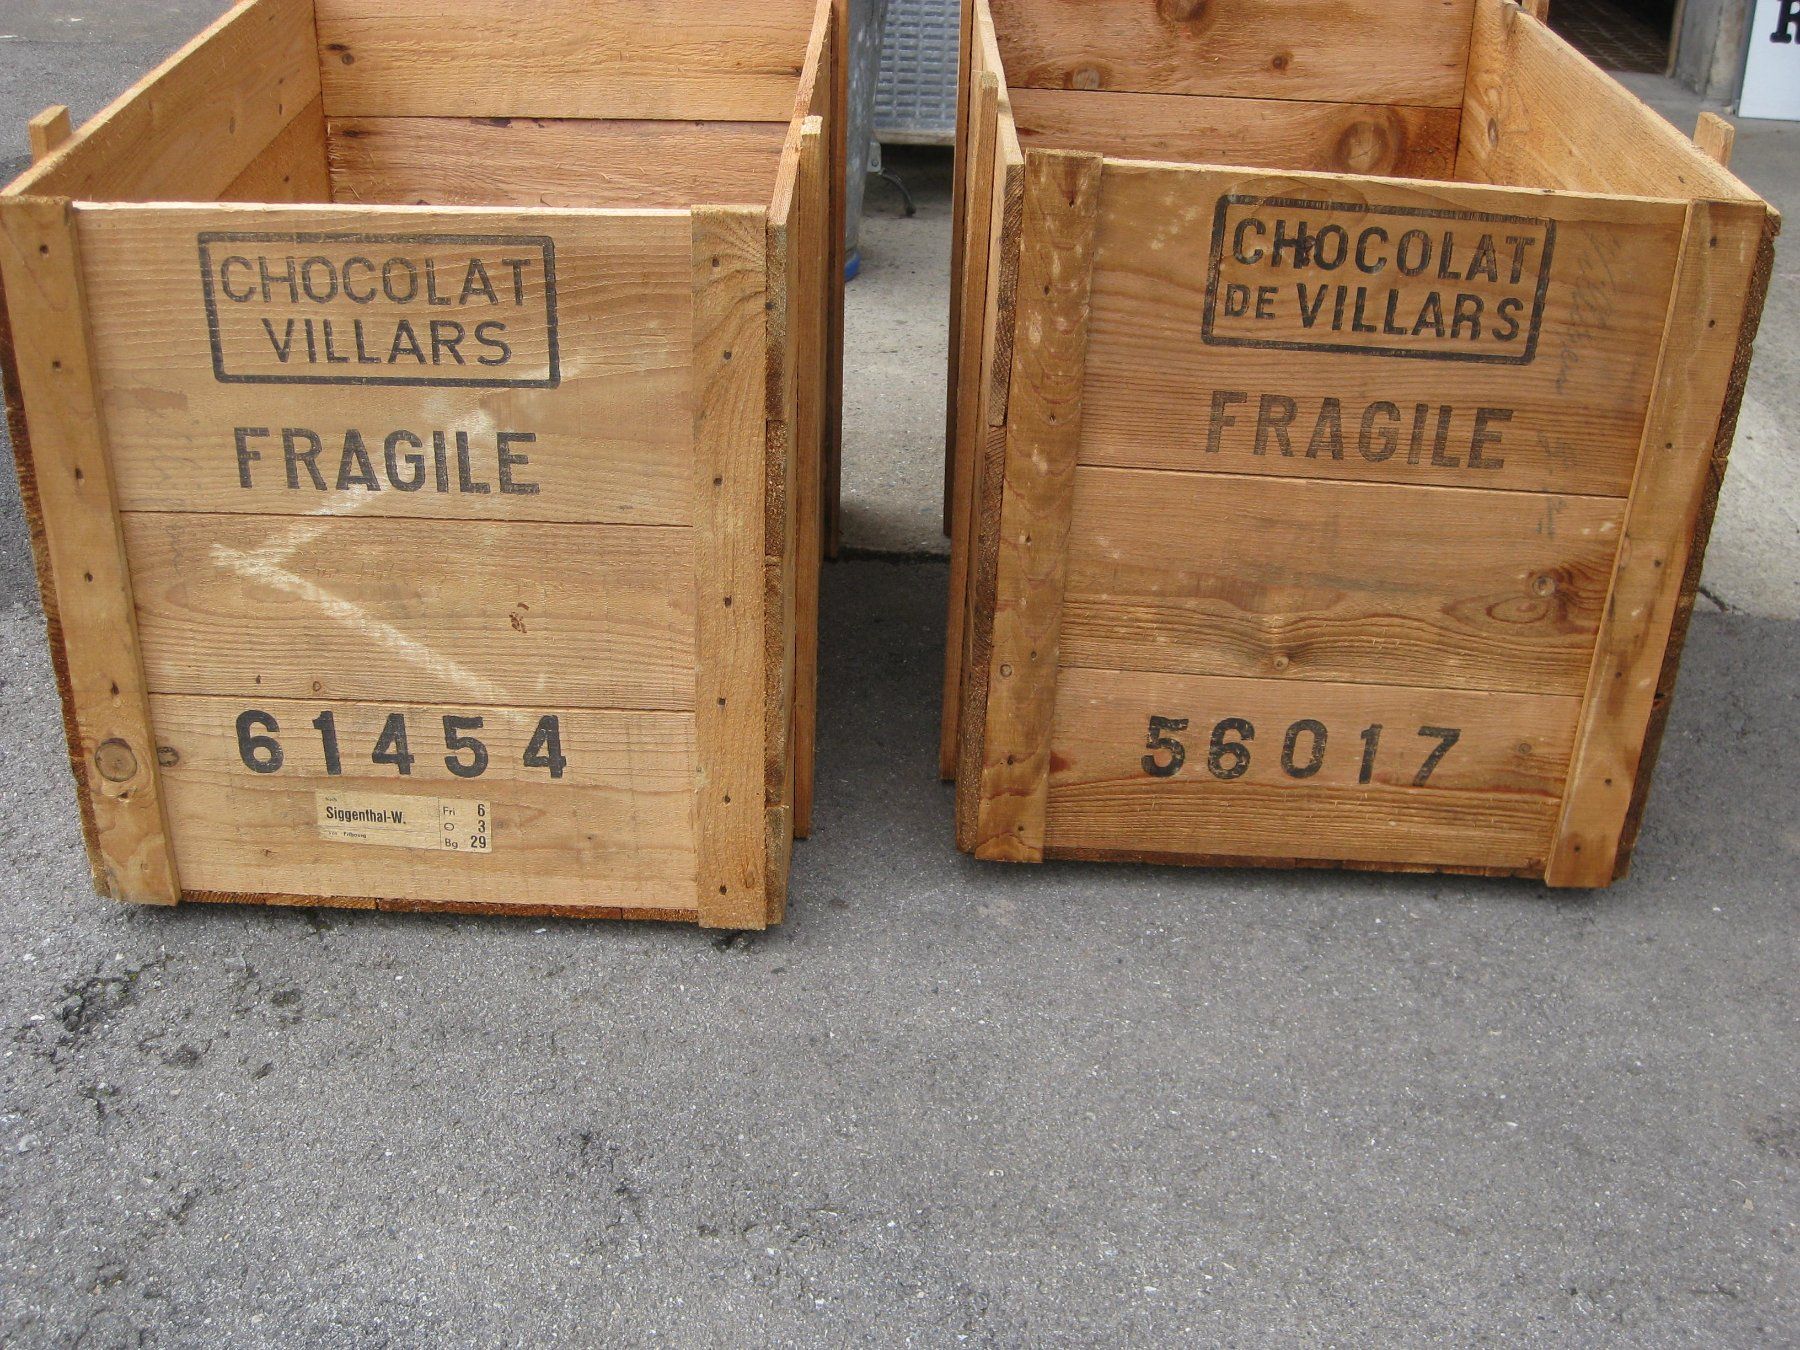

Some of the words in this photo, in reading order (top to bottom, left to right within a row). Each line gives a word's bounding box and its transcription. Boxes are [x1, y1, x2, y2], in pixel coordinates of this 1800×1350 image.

[1232, 217, 1536, 285] CHOCOLAT
[220, 255, 532, 306] CHOCOLAT
[1224, 283, 1279, 320] DE
[1296, 283, 1524, 342] VILLARS
[261, 318, 512, 366] VILLARS
[1204, 390, 1514, 469] FRAGILE
[233, 426, 541, 494] FRAGILE
[235, 709, 567, 779] 61454
[1140, 715, 1462, 787] 56017
[325, 805, 407, 825] Siggenthal-W.
[477, 803, 486, 817] 6
[477, 819, 486, 833] 3
[444, 837, 459, 850] Bg
[470, 835, 487, 849] 29
